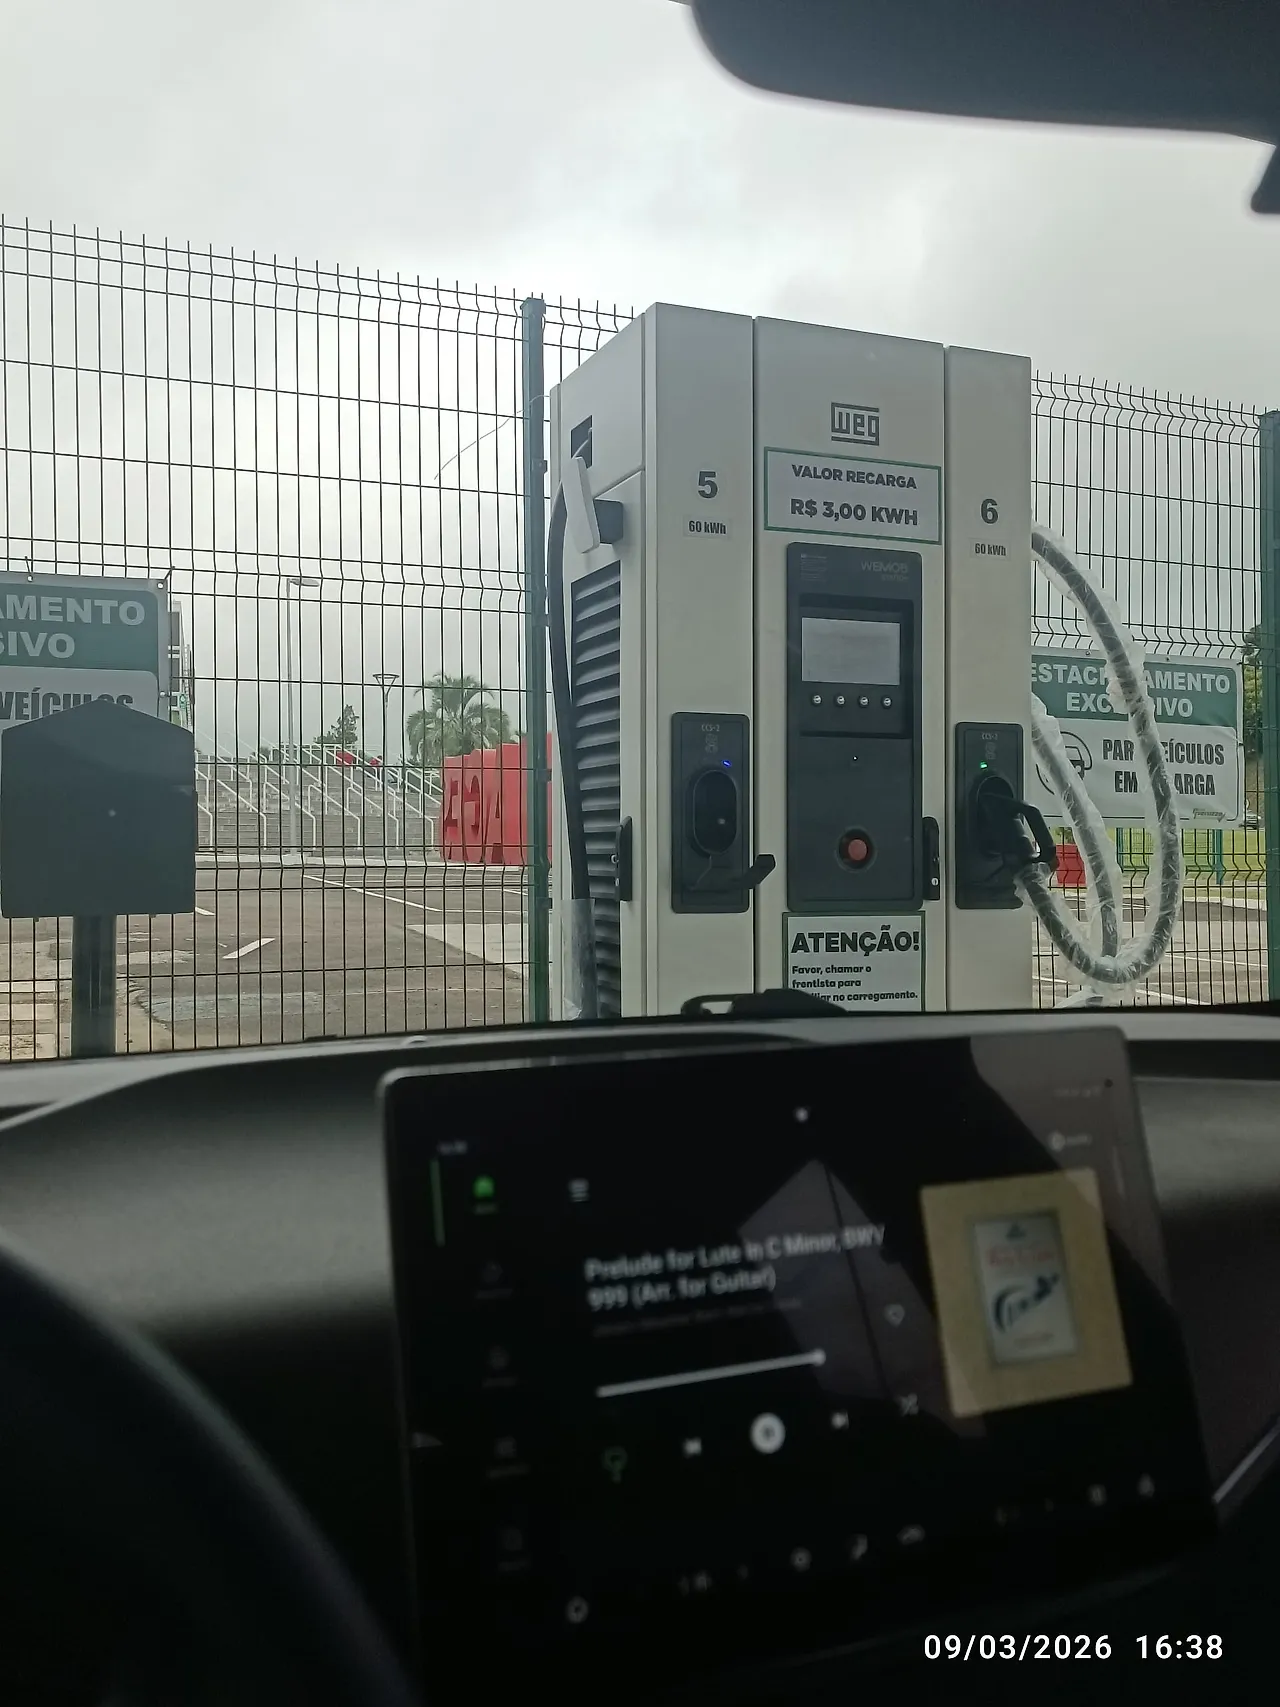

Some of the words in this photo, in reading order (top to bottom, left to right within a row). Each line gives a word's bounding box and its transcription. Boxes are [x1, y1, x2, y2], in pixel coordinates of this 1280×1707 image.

[698, 470, 718, 499] 5
[791, 464, 843, 481] VALOR
[846, 470, 918, 489] RECARGA
[790, 498, 818, 518] R$
[822, 501, 867, 521] 3,00
[871, 505, 918, 526] KWH
[980, 498, 999, 524] 6
[688, 520, 702, 533] 60
[704, 521, 727, 535] kWh
[975, 543, 987, 554] 60
[987, 544, 1006, 557] kWh
[0, 594, 146, 626] MENTO
[1031, 662, 1231, 694] STACIAMENTO
[1066, 692, 1193, 718] EXCIVO
[1102, 739, 1135, 761] PAR
[1160, 738, 1225, 766] ÍCULOS
[1114, 771, 1138, 793] EM
[791, 924, 920, 957] ATENÇÃO!
[792, 965, 823, 975] Favor,
[825, 965, 864, 974] chamar
[792, 979, 836, 989] frentista
[837, 979, 862, 989] para
[833, 992, 845, 1002] no
[847, 990, 918, 1002] carregamento.
[585, 1252, 663, 1281] Prelude
[665, 1246, 696, 1272] for
[698, 1243, 741, 1268] Lute
[745, 1240, 764, 1261] in
[766, 1236, 782, 1260] C
[588, 1284, 629, 1311] 999
[676, 1275, 706, 1299] for
[710, 1264, 777, 1295] Guitar)
